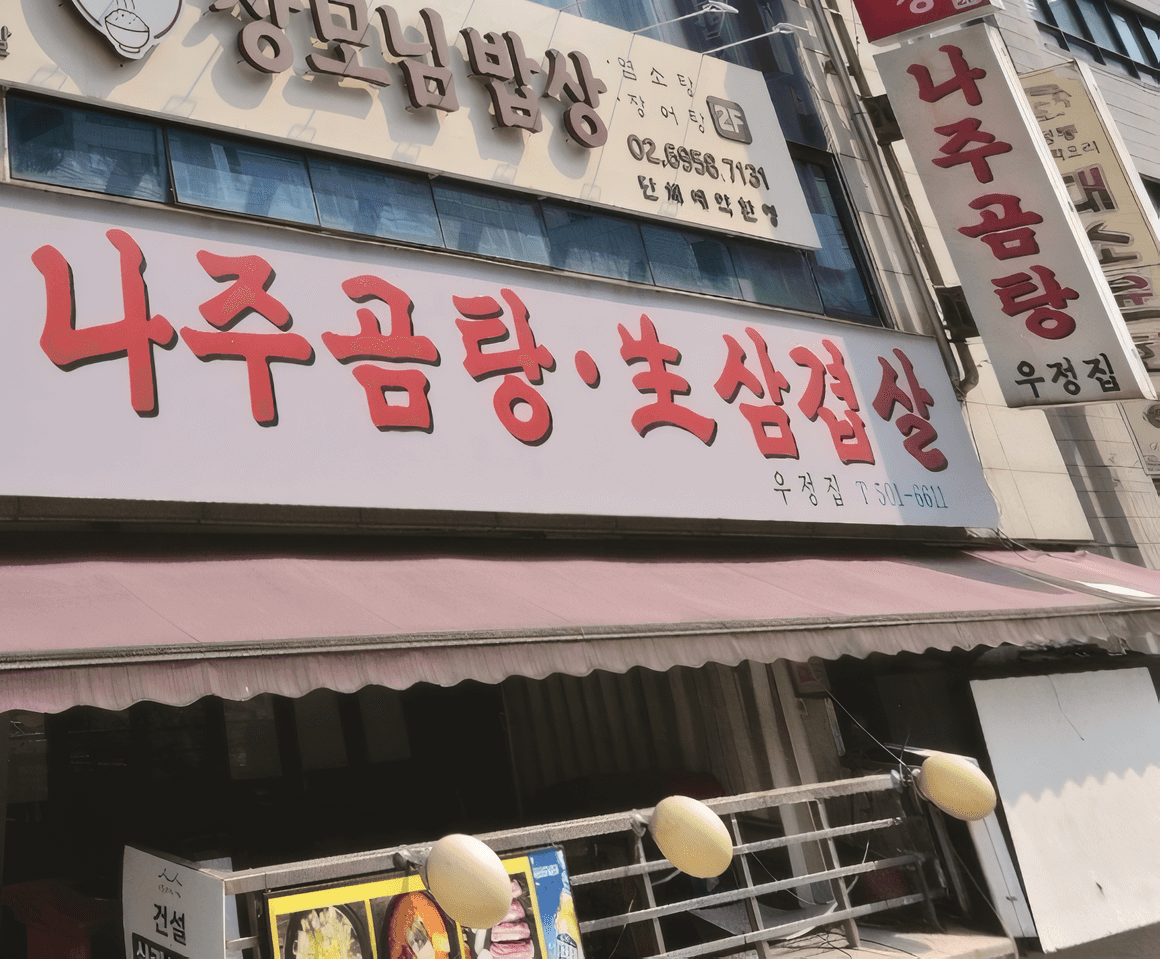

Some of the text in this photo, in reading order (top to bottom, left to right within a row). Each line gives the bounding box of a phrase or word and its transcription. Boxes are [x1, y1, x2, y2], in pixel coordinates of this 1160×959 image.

[711, 101, 746, 136] 2F
[907, 44, 1079, 340] 나주곰탕
[1014, 353, 1121, 398] 우정집
[774, 471, 844, 506] 우정집
